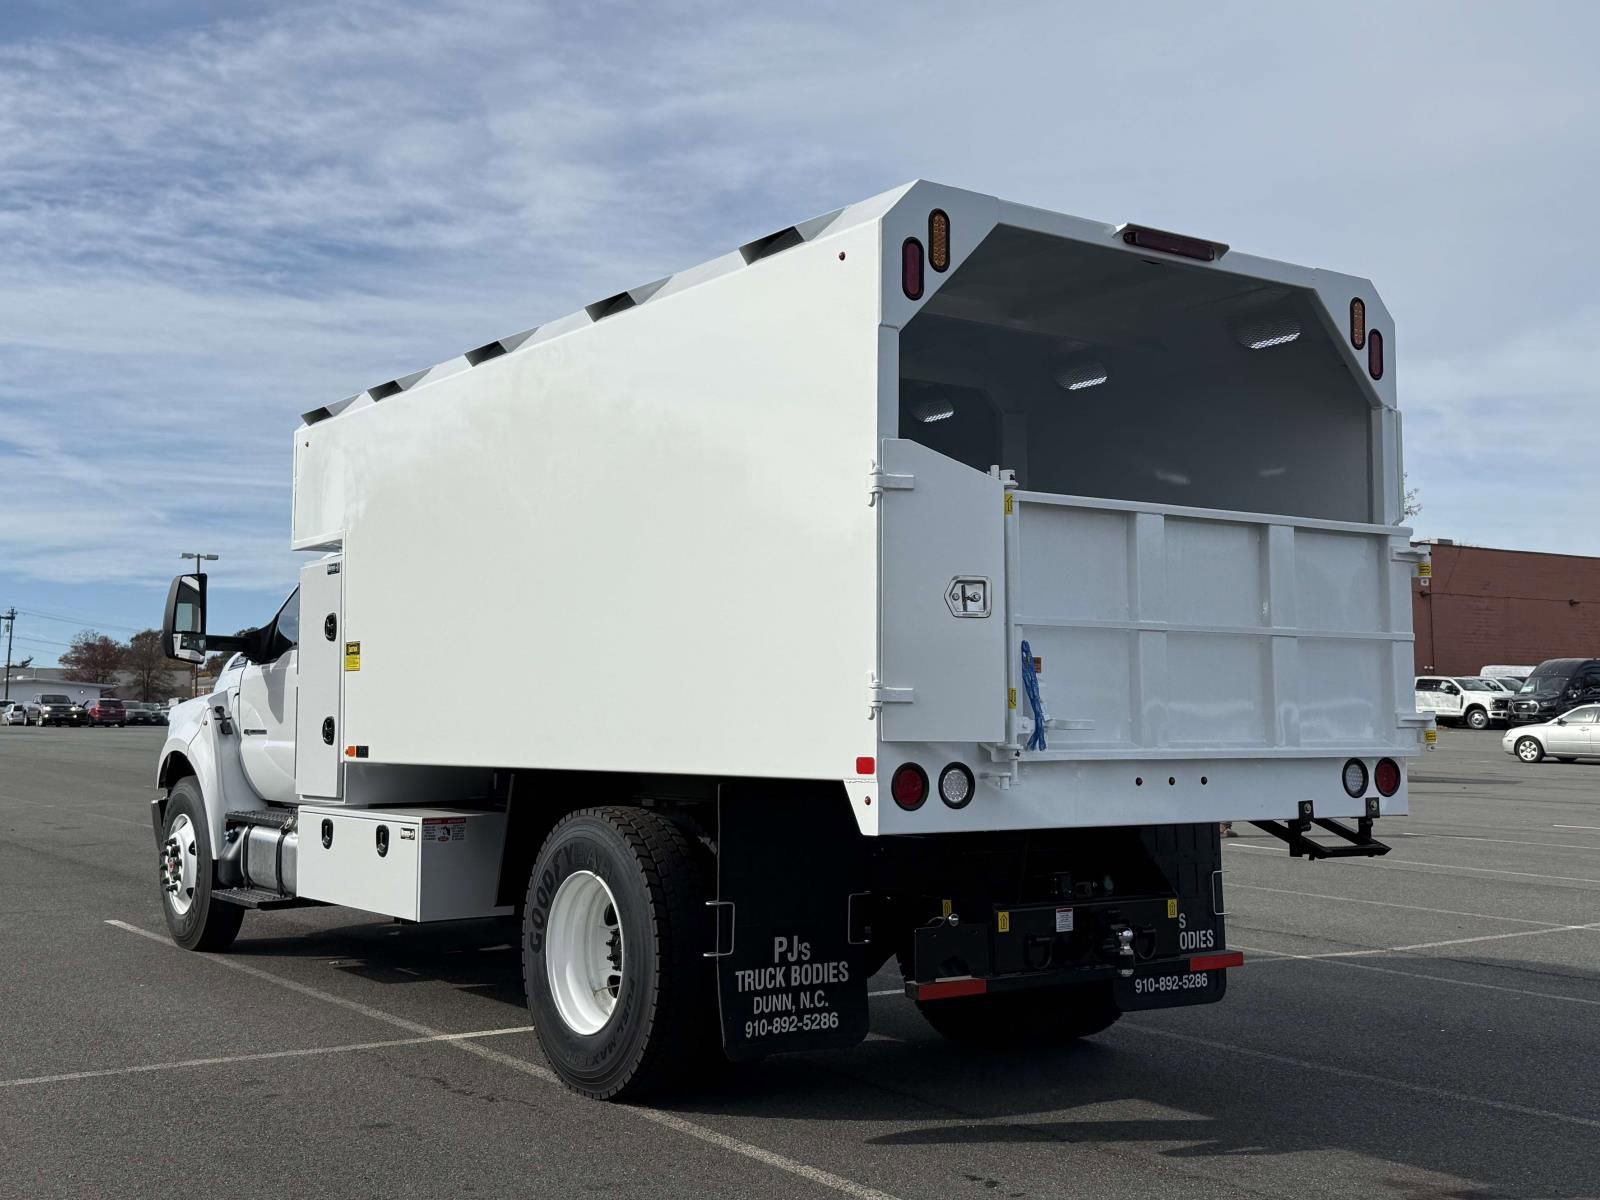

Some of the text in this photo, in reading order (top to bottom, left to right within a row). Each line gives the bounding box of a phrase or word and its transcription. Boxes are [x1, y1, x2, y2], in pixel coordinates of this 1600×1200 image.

[1179, 929, 1214, 950] ODIES
[735, 961, 849, 992] TRUCK BODIES
[1135, 973, 1208, 994] 910-892-5286
[753, 990, 829, 1014] DUNN, N.C.
[745, 1012, 839, 1038] 910-892-5286
